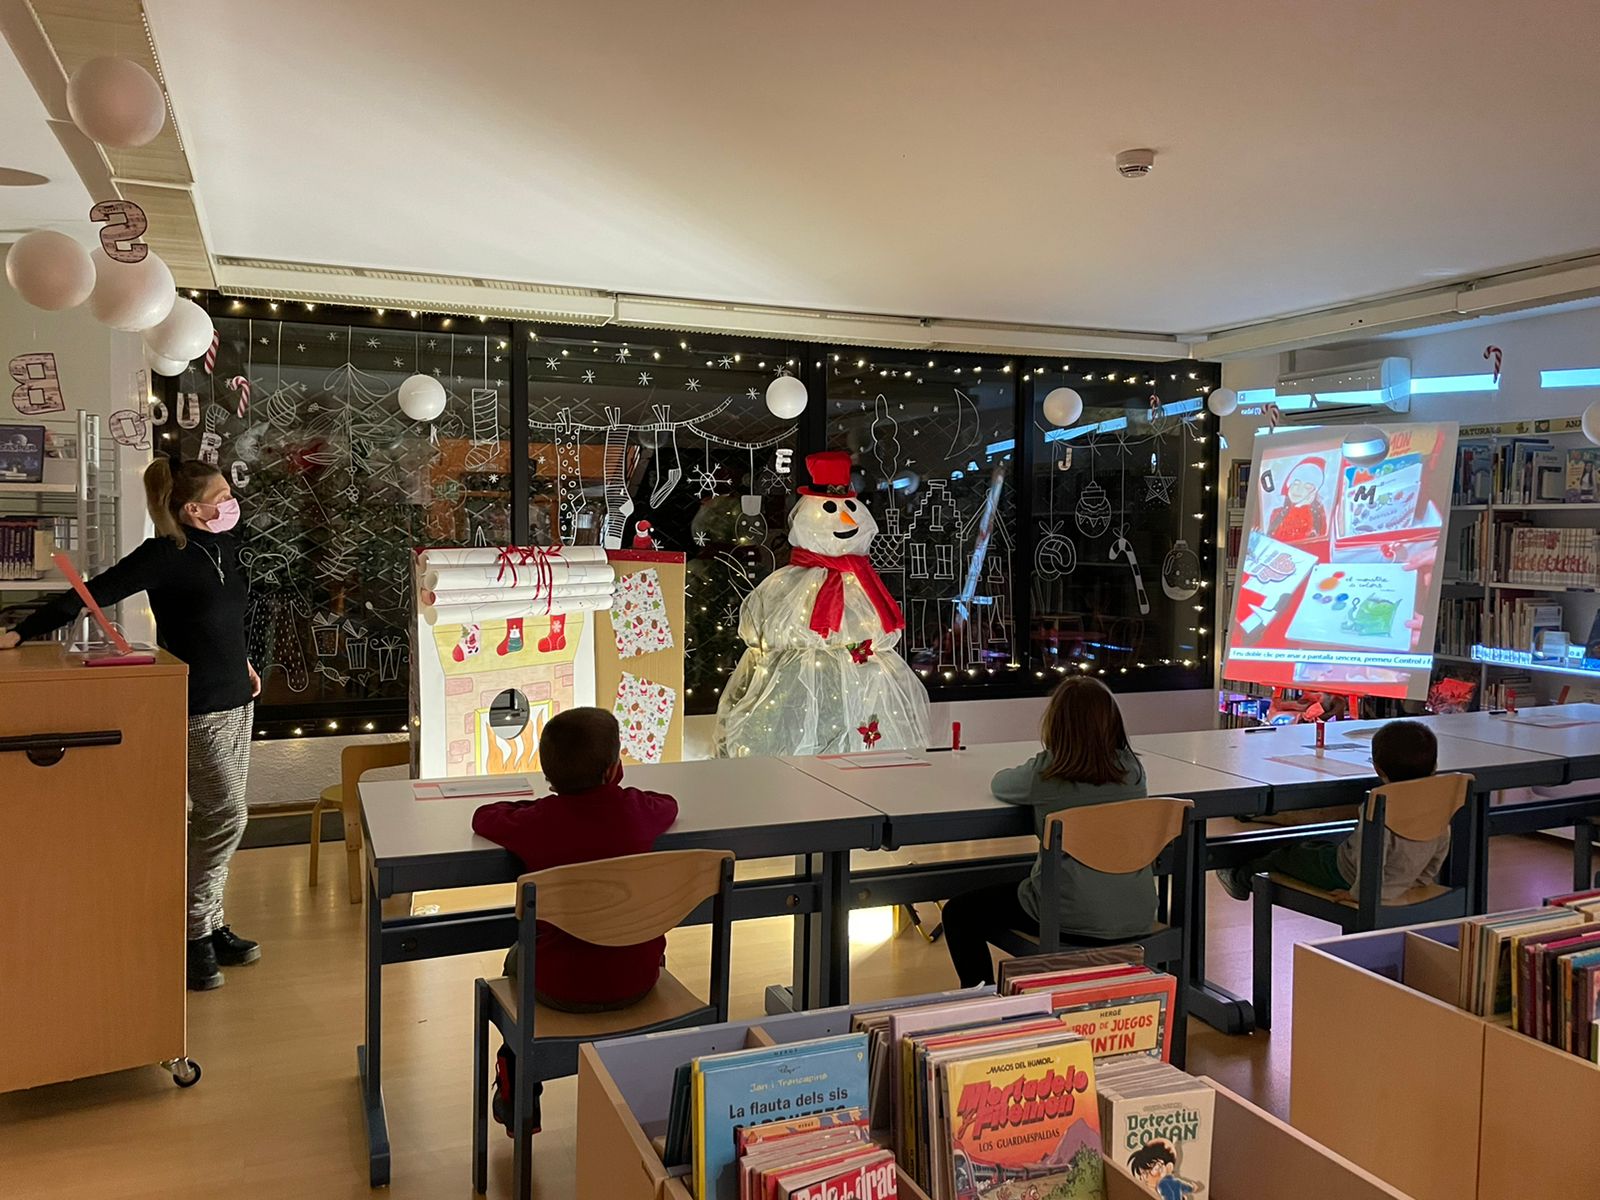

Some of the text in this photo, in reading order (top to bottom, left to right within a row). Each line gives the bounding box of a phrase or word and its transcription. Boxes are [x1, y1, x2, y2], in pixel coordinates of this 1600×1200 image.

[109, 409, 151, 451] Q
[776, 449, 794, 473] E
[1354, 485, 1376, 504] M
[1307, 653, 1334, 662] pantalla
[1394, 656, 1421, 665] Control
[1110, 1015, 1153, 1032] JUEGOS
[856, 1052, 864, 1062] 9
[1014, 1061, 1026, 1070] DEL
[1027, 1057, 1054, 1069] HUMOR
[729, 1087, 848, 1120] La flauta dels sis
[1127, 1109, 1199, 1131] Detectiu
[979, 1128, 1060, 1153] LOS GUARDAESPALDAS
[1126, 1123, 1198, 1149] CONAN
